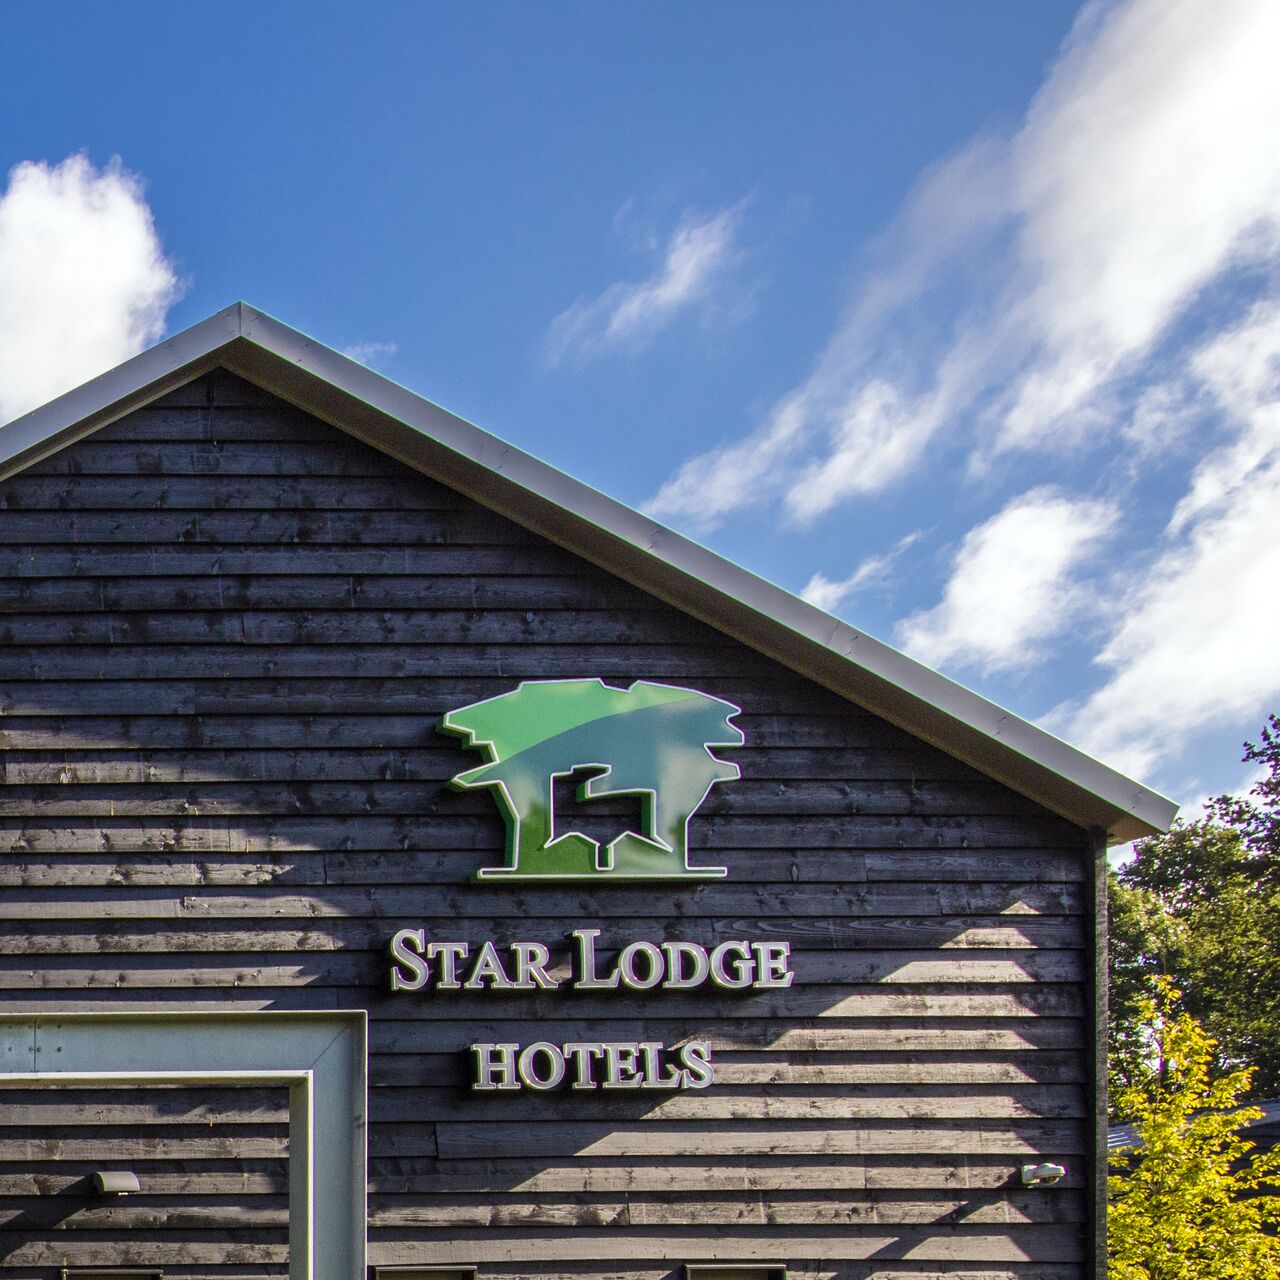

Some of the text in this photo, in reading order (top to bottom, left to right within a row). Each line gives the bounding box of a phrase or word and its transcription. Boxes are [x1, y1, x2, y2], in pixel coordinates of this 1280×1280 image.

[390, 929, 794, 991] STAR LODGE
[471, 1041, 715, 1090] HOTELS
